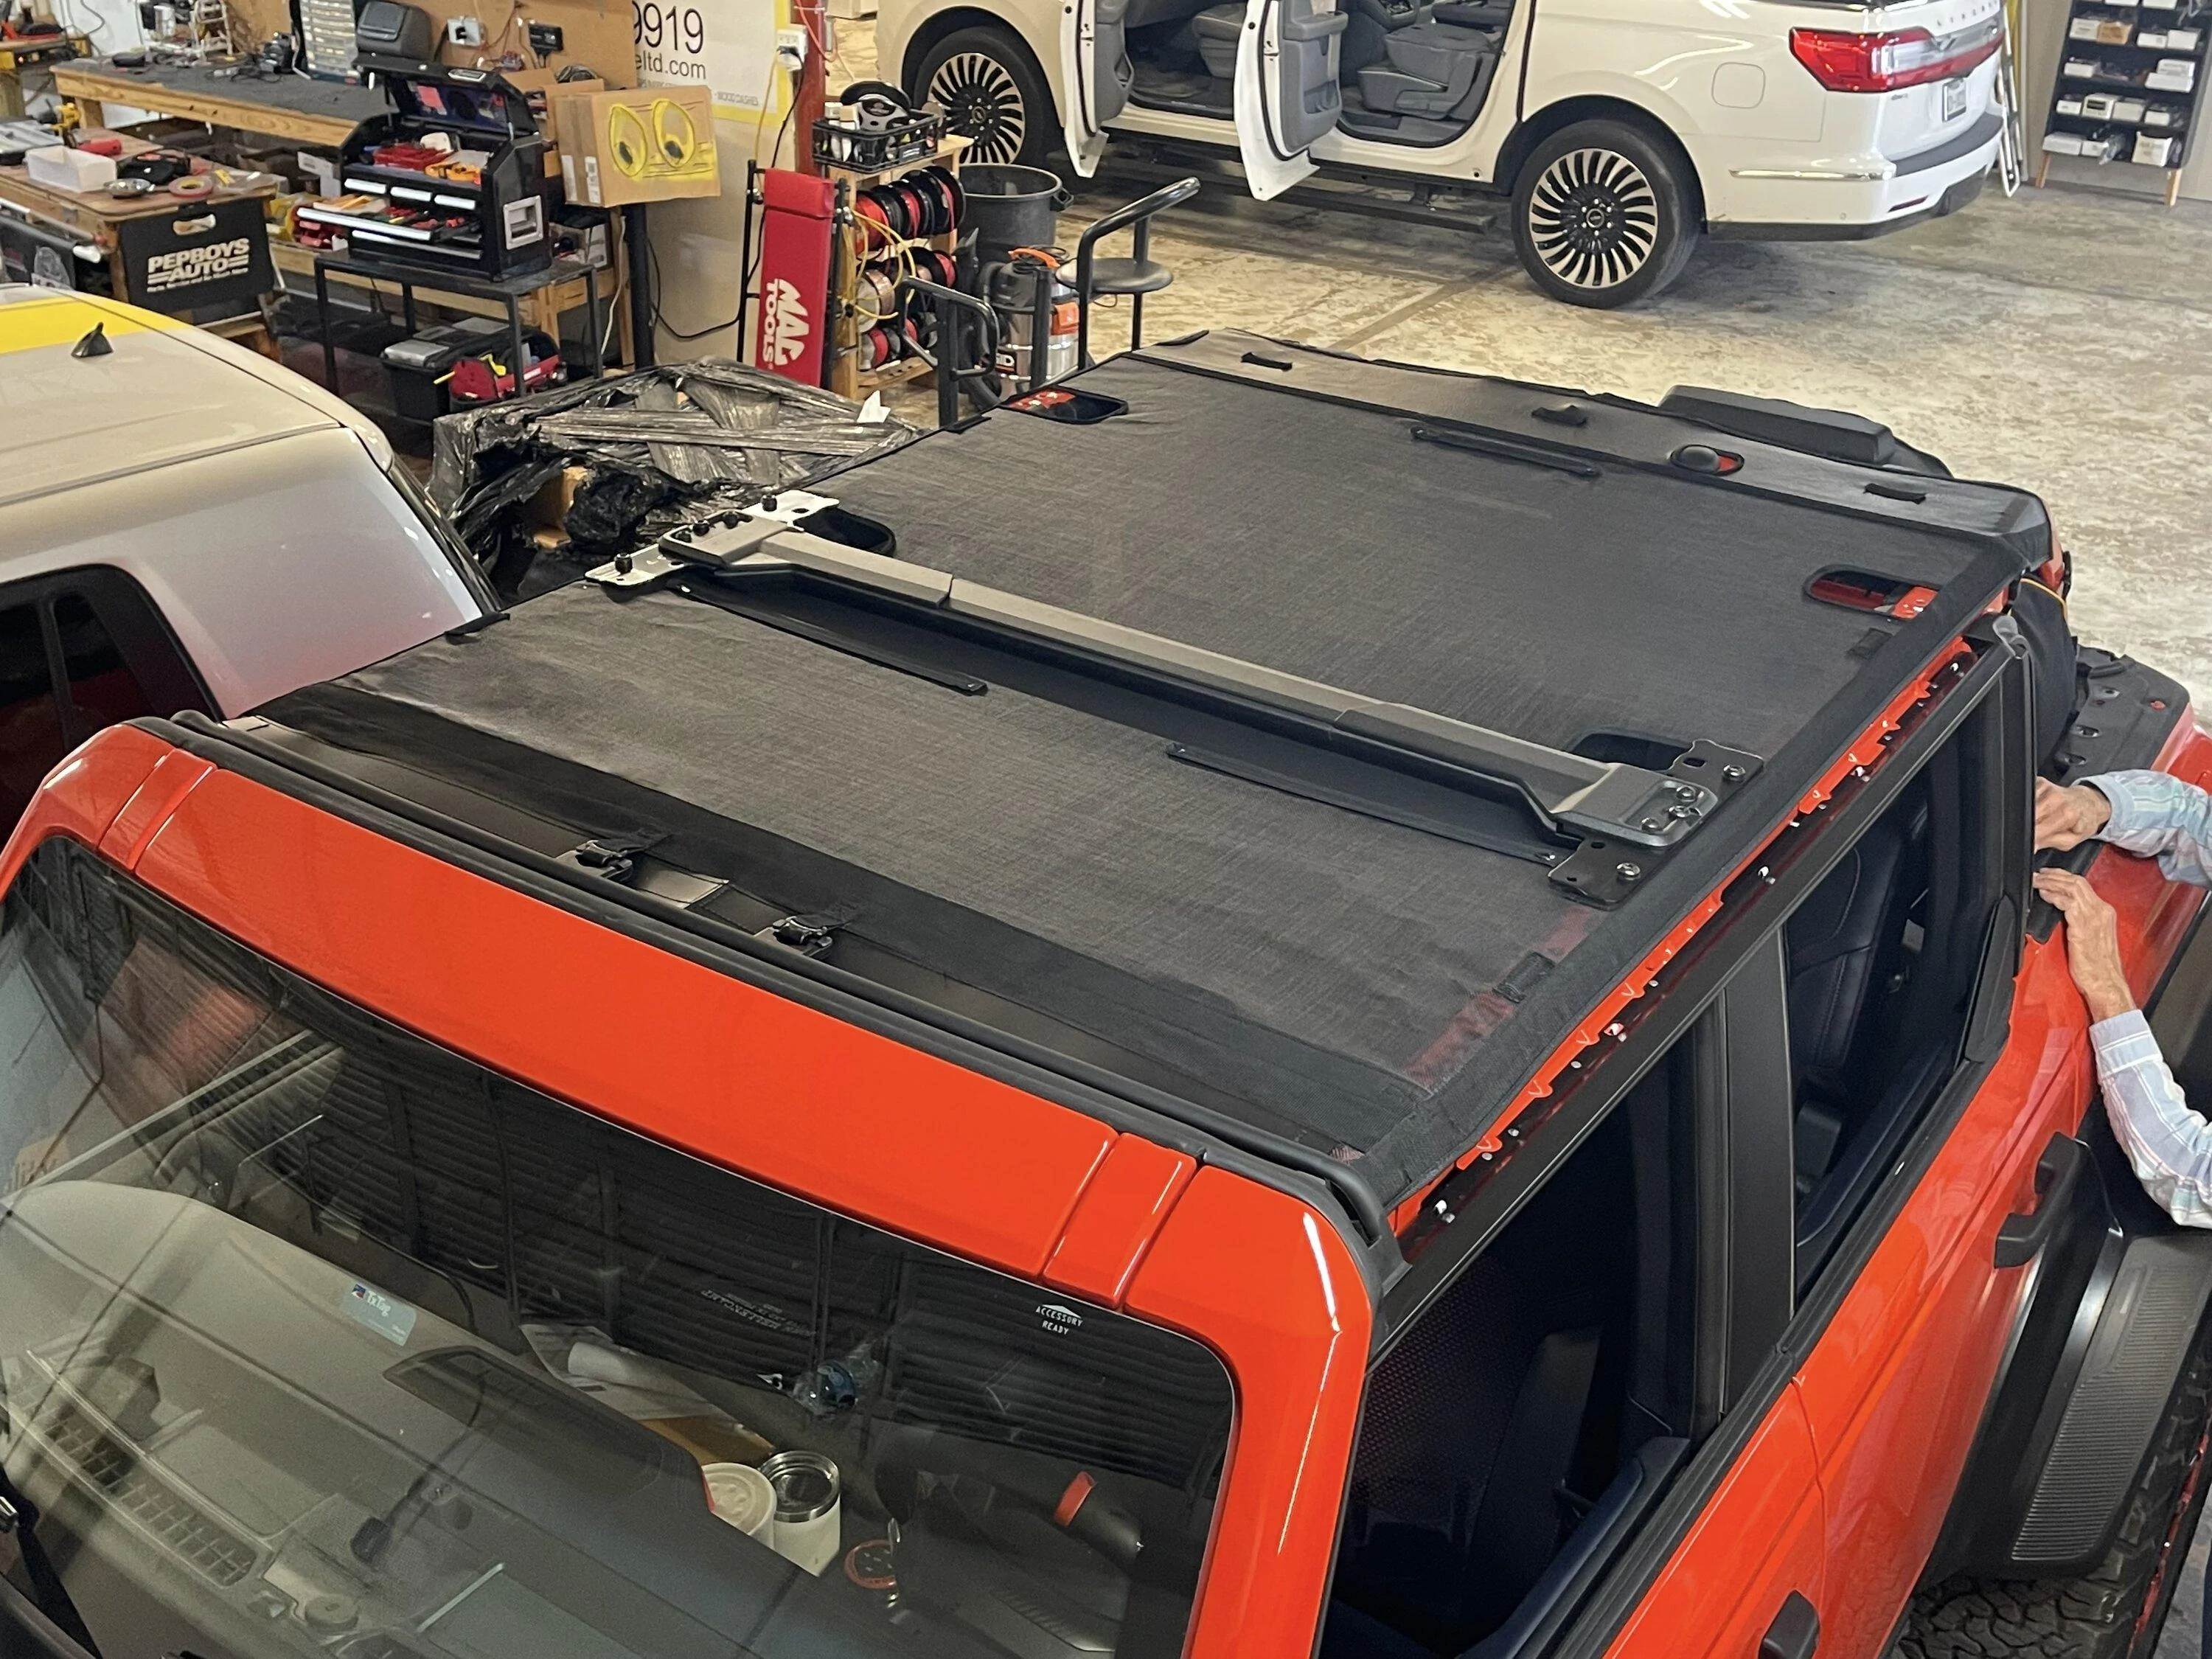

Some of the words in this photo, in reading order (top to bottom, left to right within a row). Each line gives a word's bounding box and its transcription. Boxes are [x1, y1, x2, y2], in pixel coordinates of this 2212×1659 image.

[635, 51, 706, 80] eltd.com
[147, 237, 250, 274] PEPBOYS
[168, 258, 229, 282] AUTO
[762, 278, 779, 362] TOOLS
[774, 279, 810, 366] MAC
[1035, 1306, 1083, 1327] ACCESSORY
[1042, 1320, 1069, 1335] READY
